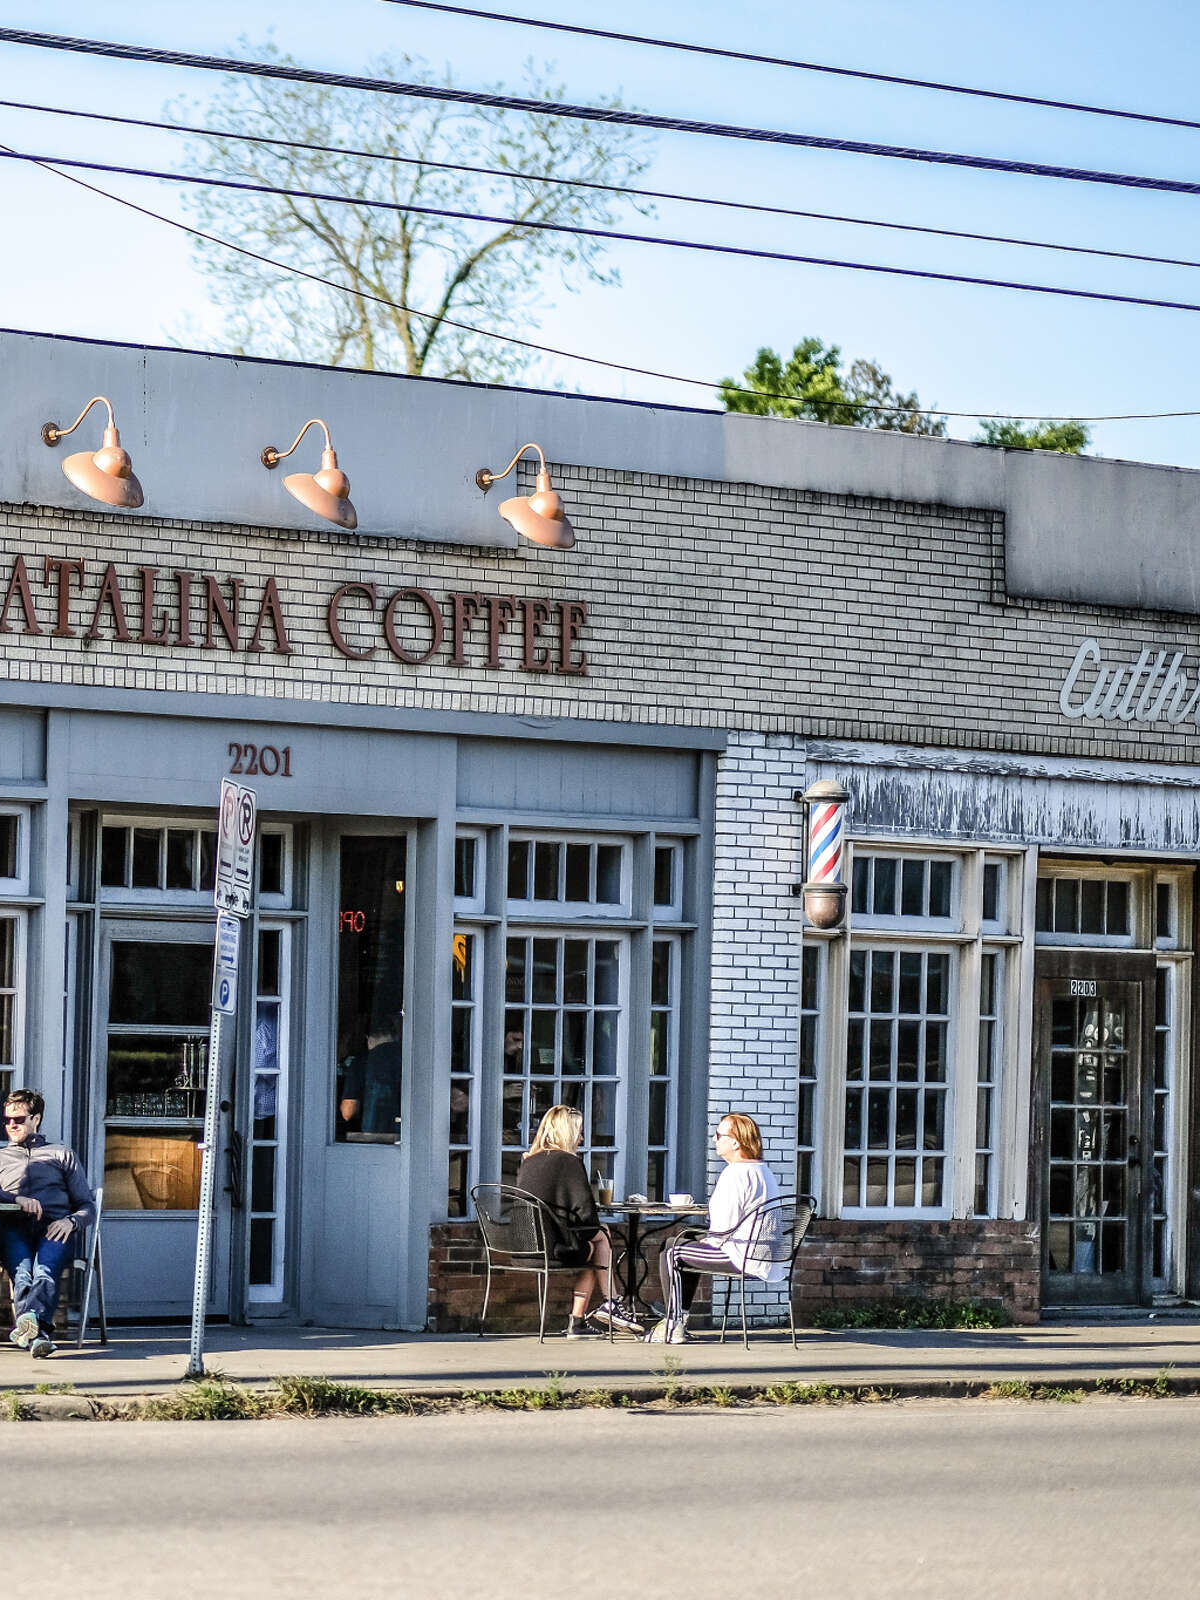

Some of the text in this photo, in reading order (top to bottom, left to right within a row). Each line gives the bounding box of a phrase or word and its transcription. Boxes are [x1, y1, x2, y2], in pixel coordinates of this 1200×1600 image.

[328, 582, 588, 676] COFFEE
[1059, 638, 1200, 726] Cutth
[228, 743, 293, 777] 2201
[1071, 980, 1097, 996] 2203
